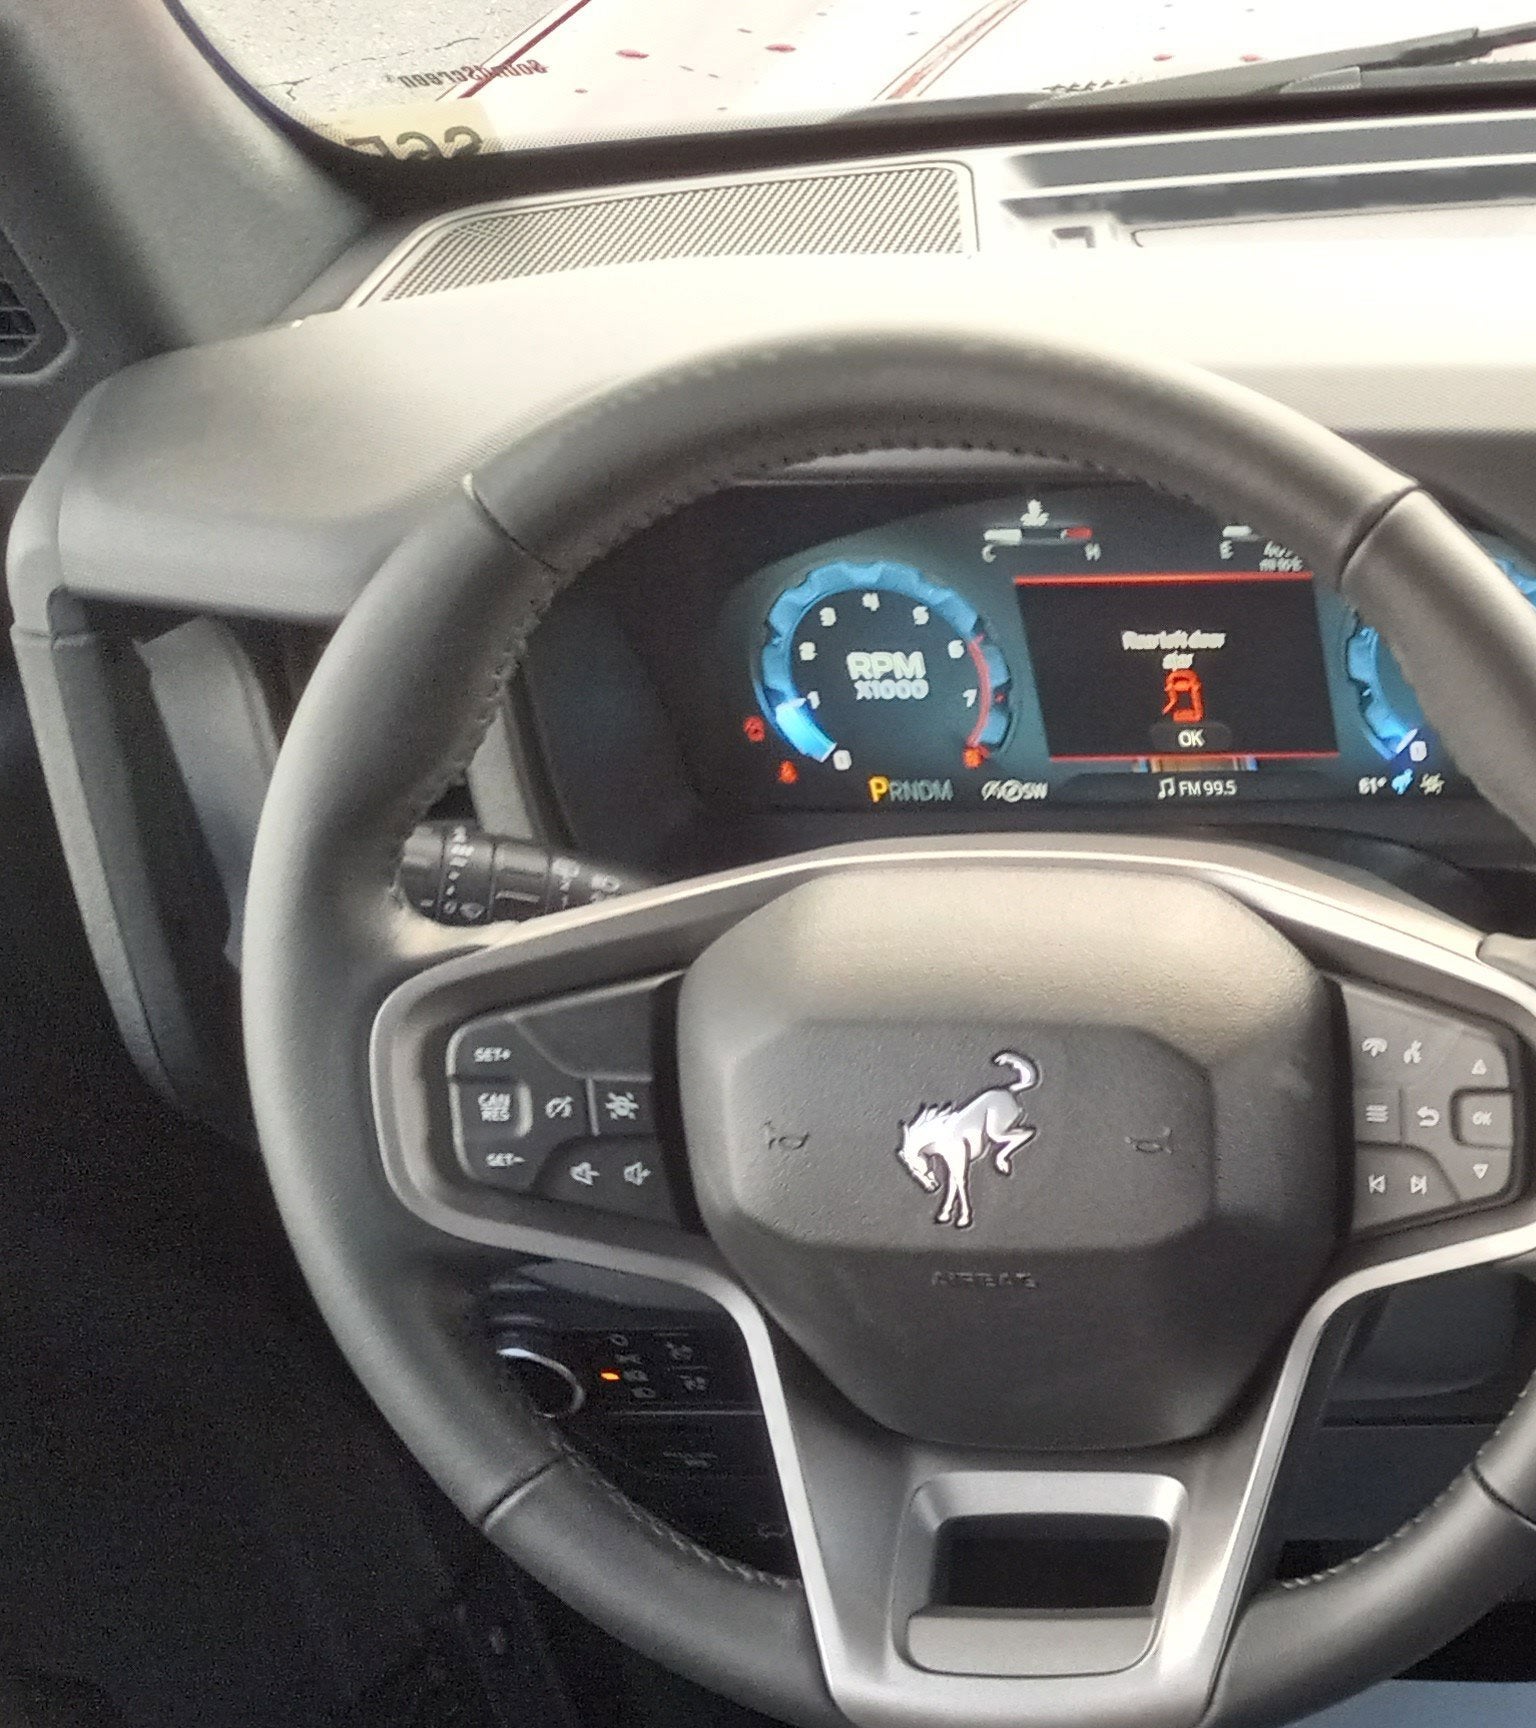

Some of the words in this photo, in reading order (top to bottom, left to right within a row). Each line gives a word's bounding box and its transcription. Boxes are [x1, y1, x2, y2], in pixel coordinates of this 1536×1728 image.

[846, 651, 926, 680] RPM
[1178, 730, 1205, 748] OK
[1180, 781, 1201, 796] FM
[1203, 780, 1237, 797] 99.5
